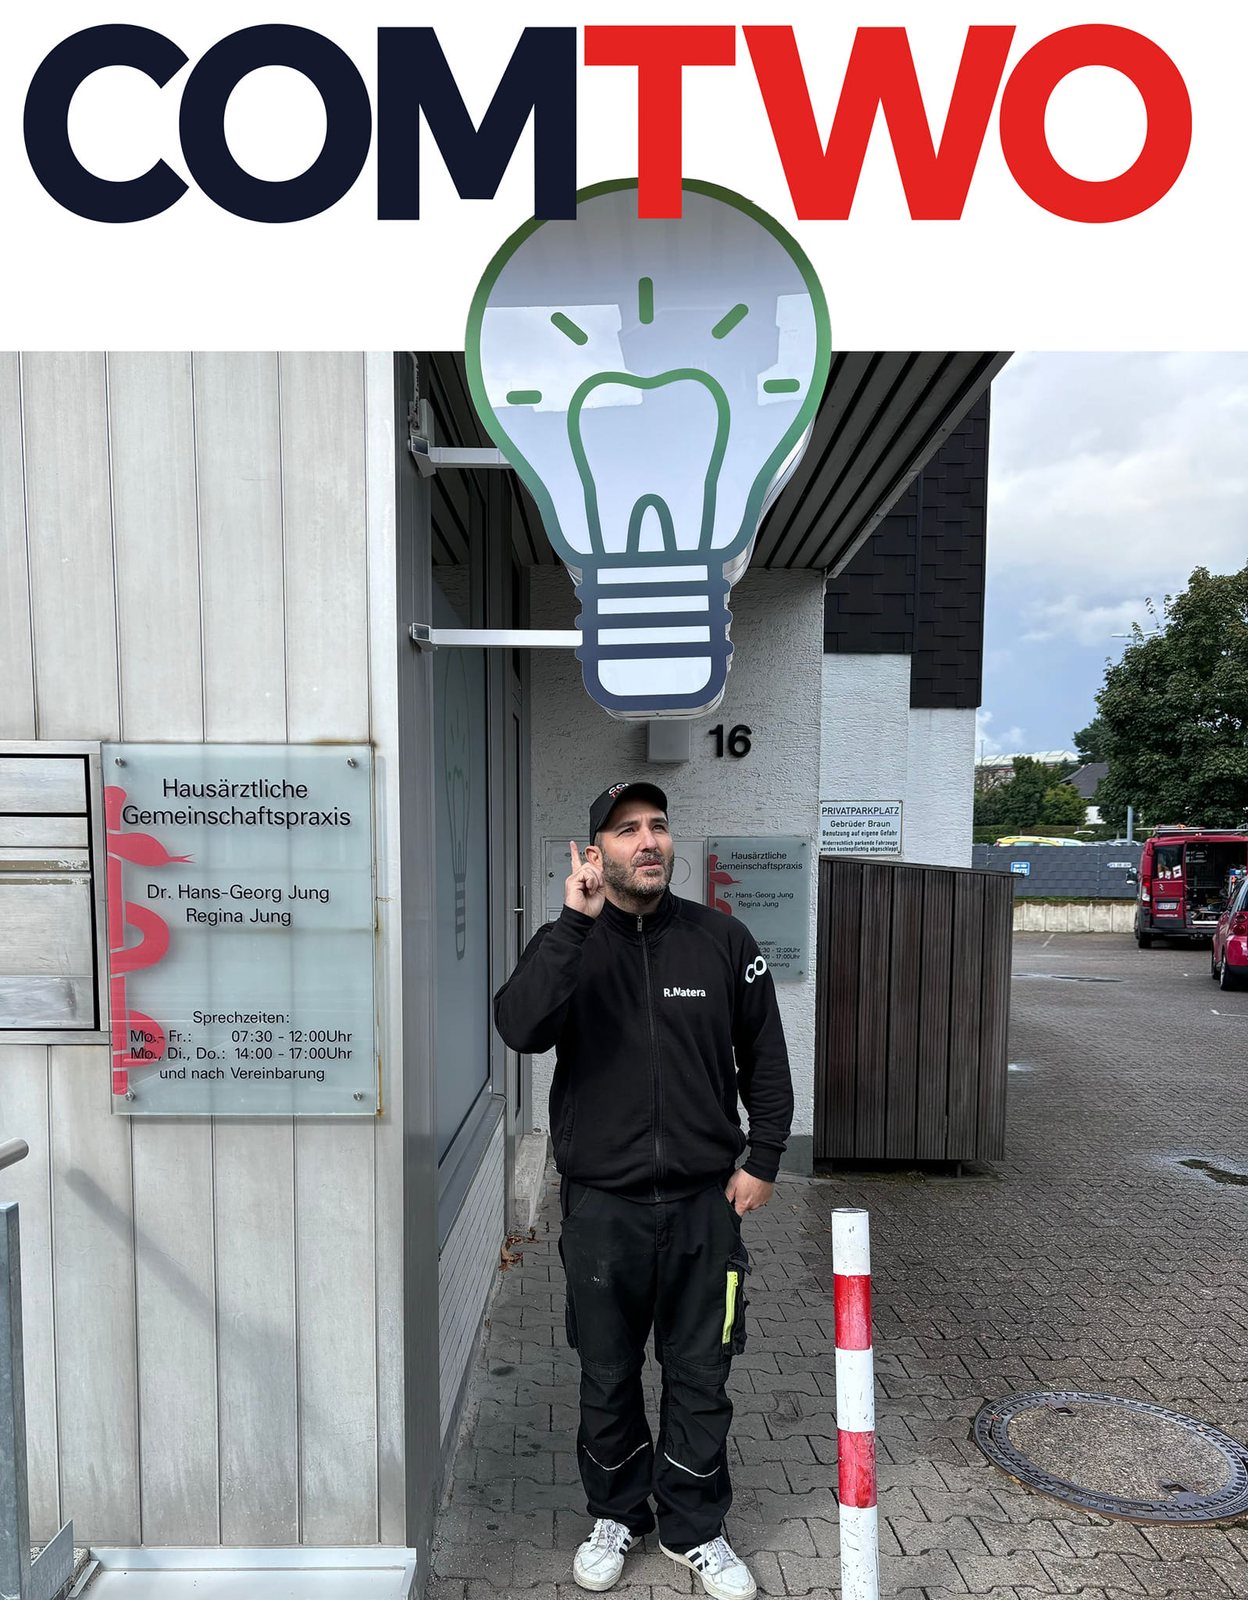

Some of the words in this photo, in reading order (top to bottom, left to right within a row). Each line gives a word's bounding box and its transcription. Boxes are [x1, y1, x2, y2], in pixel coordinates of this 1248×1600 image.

[709, 724, 752, 757] 16
[163, 778, 308, 799] Hausärztliche
[821, 806, 900, 815] PRIVATPARKPLATZ
[122, 805, 351, 829] Gemeinschaftspraxis
[830, 820, 866, 828] Gebrüder
[867, 820, 891, 828] Braun
[822, 829, 850, 838] Benutzung
[861, 829, 879, 838] eigene
[731, 851, 787, 860] Hausärztliche
[715, 861, 803, 871] Gemeinschaftspraxis
[147, 884, 172, 900] Dr.
[178, 884, 282, 903] Hans-Georg
[288, 885, 330, 903] Jung
[735, 891, 776, 899] Hans-Georg
[777, 891, 794, 899] Jung
[738, 900, 761, 909] Regina
[762, 900, 779, 908] Jung
[186, 908, 243, 926] Regina
[249, 908, 291, 926] Jung
[663, 986, 706, 998] R.Natera
[193, 1010, 290, 1026] Sprechzeiten:
[169, 1030, 192, 1042] Fr.:
[231, 1030, 273, 1042] 07:30
[288, 1030, 353, 1042] 12:00Uhr
[130, 1047, 162, 1060] Mo.,
[167, 1047, 191, 1060] Di.,
[196, 1047, 225, 1060] Do.:
[234, 1047, 273, 1060] 14:00
[288, 1047, 353, 1060] 17:00Uhr
[159, 1067, 186, 1079] und
[191, 1067, 225, 1079] nach
[230, 1067, 325, 1082] Vereinbarung
